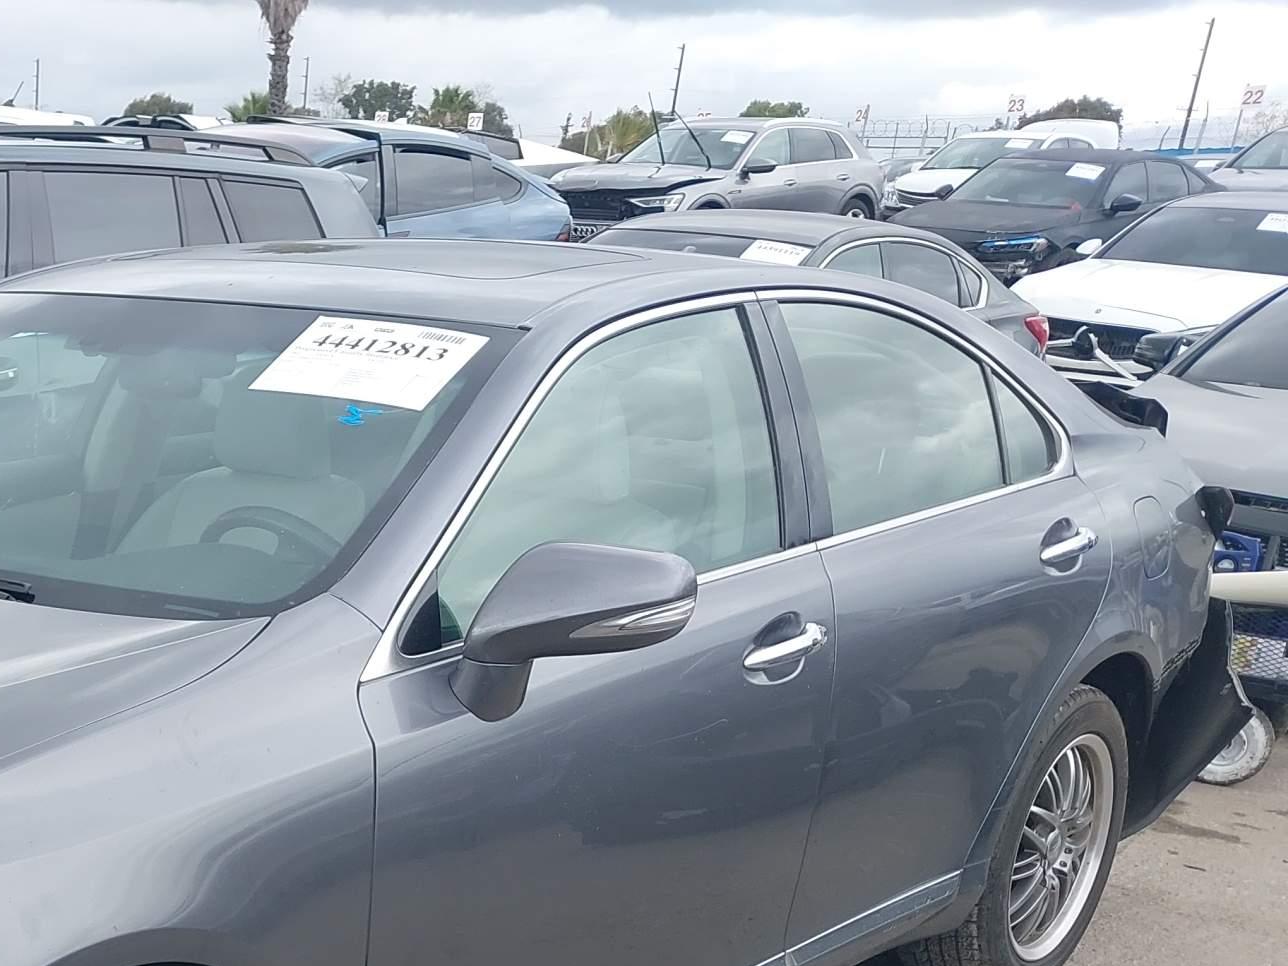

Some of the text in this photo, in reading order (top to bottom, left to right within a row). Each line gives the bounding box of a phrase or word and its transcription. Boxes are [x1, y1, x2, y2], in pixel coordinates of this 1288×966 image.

[1242, 90, 1264, 104] 22
[1008, 98, 1024, 112] 23
[468, 116, 482, 127] 27
[313, 334, 449, 361] 44412813
